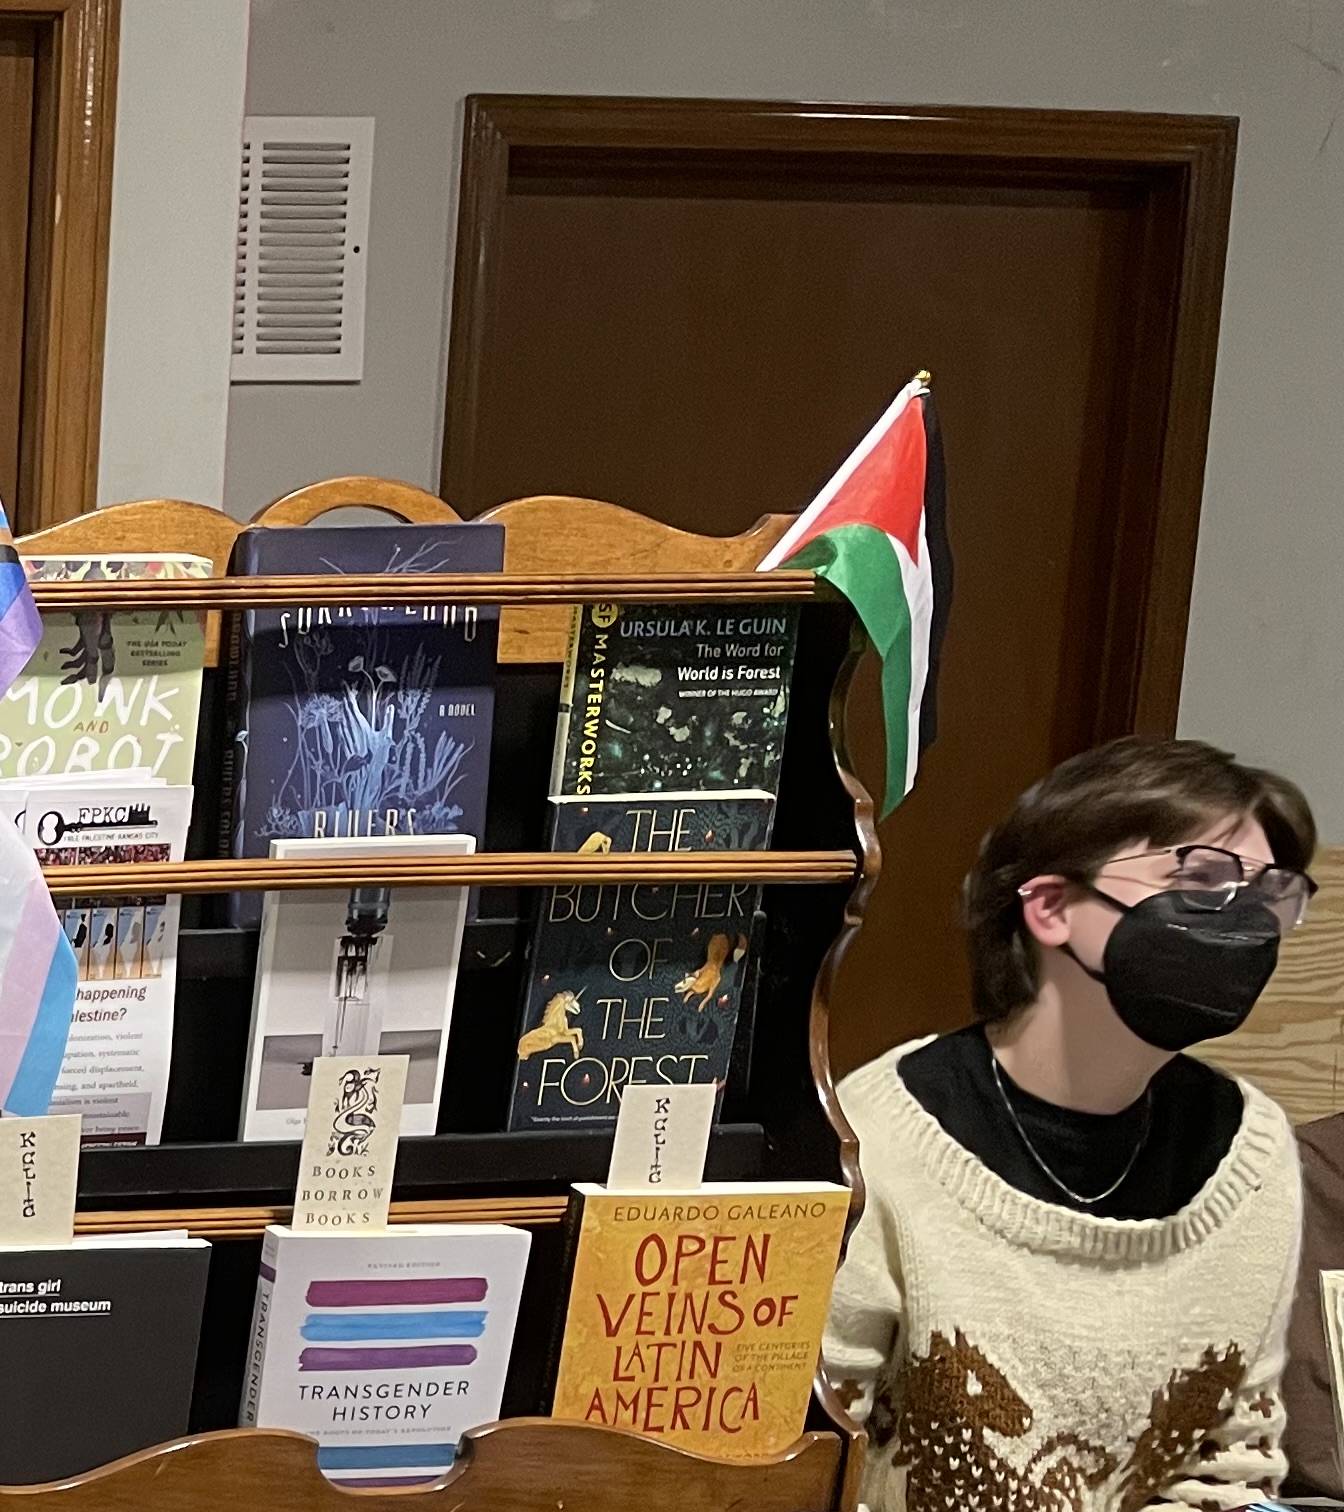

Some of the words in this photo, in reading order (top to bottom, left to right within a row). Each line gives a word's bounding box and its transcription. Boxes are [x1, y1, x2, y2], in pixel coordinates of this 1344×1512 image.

[619, 619, 692, 638] URSULA
[695, 619, 711, 636] K.
[717, 618, 736, 635] LE
[739, 617, 787, 635] GUIN
[697, 643, 722, 658] The
[725, 642, 761, 658] Word
[764, 641, 784, 657] for
[677, 666, 719, 681] World
[722, 665, 734, 680] is
[737, 664, 781, 680] Forest
[447, 703, 476, 717] NOVEL
[576, 633, 610, 796] MASTERWORKS
[73, 720, 110, 734] AND
[314, 808, 417, 838] RIVERS
[625, 808, 696, 853] THE
[548, 883, 751, 923] BUTCHER
[608, 937, 673, 982] OF
[75, 985, 148, 1003] happening
[595, 997, 670, 1040] THE
[312, 1164, 375, 1180] BOOKS
[301, 1187, 384, 1202] BORROW
[305, 1212, 370, 1227] BOOKS
[613, 1204, 720, 1222] EDUARDO
[727, 1202, 827, 1221] GALEANO
[634, 1233, 772, 1287] OPEN
[37, 1279, 62, 1296] girl
[50, 1300, 112, 1312] museum
[596, 1289, 745, 1338] VEINS
[752, 1294, 799, 1328] OF
[245, 1292, 271, 1424] TRANSGENDER
[612, 1340, 722, 1382] LATIN
[298, 1381, 471, 1401] TRANSGENDER
[332, 1403, 433, 1422] HISTORY
[585, 1381, 760, 1434] AMERICA
